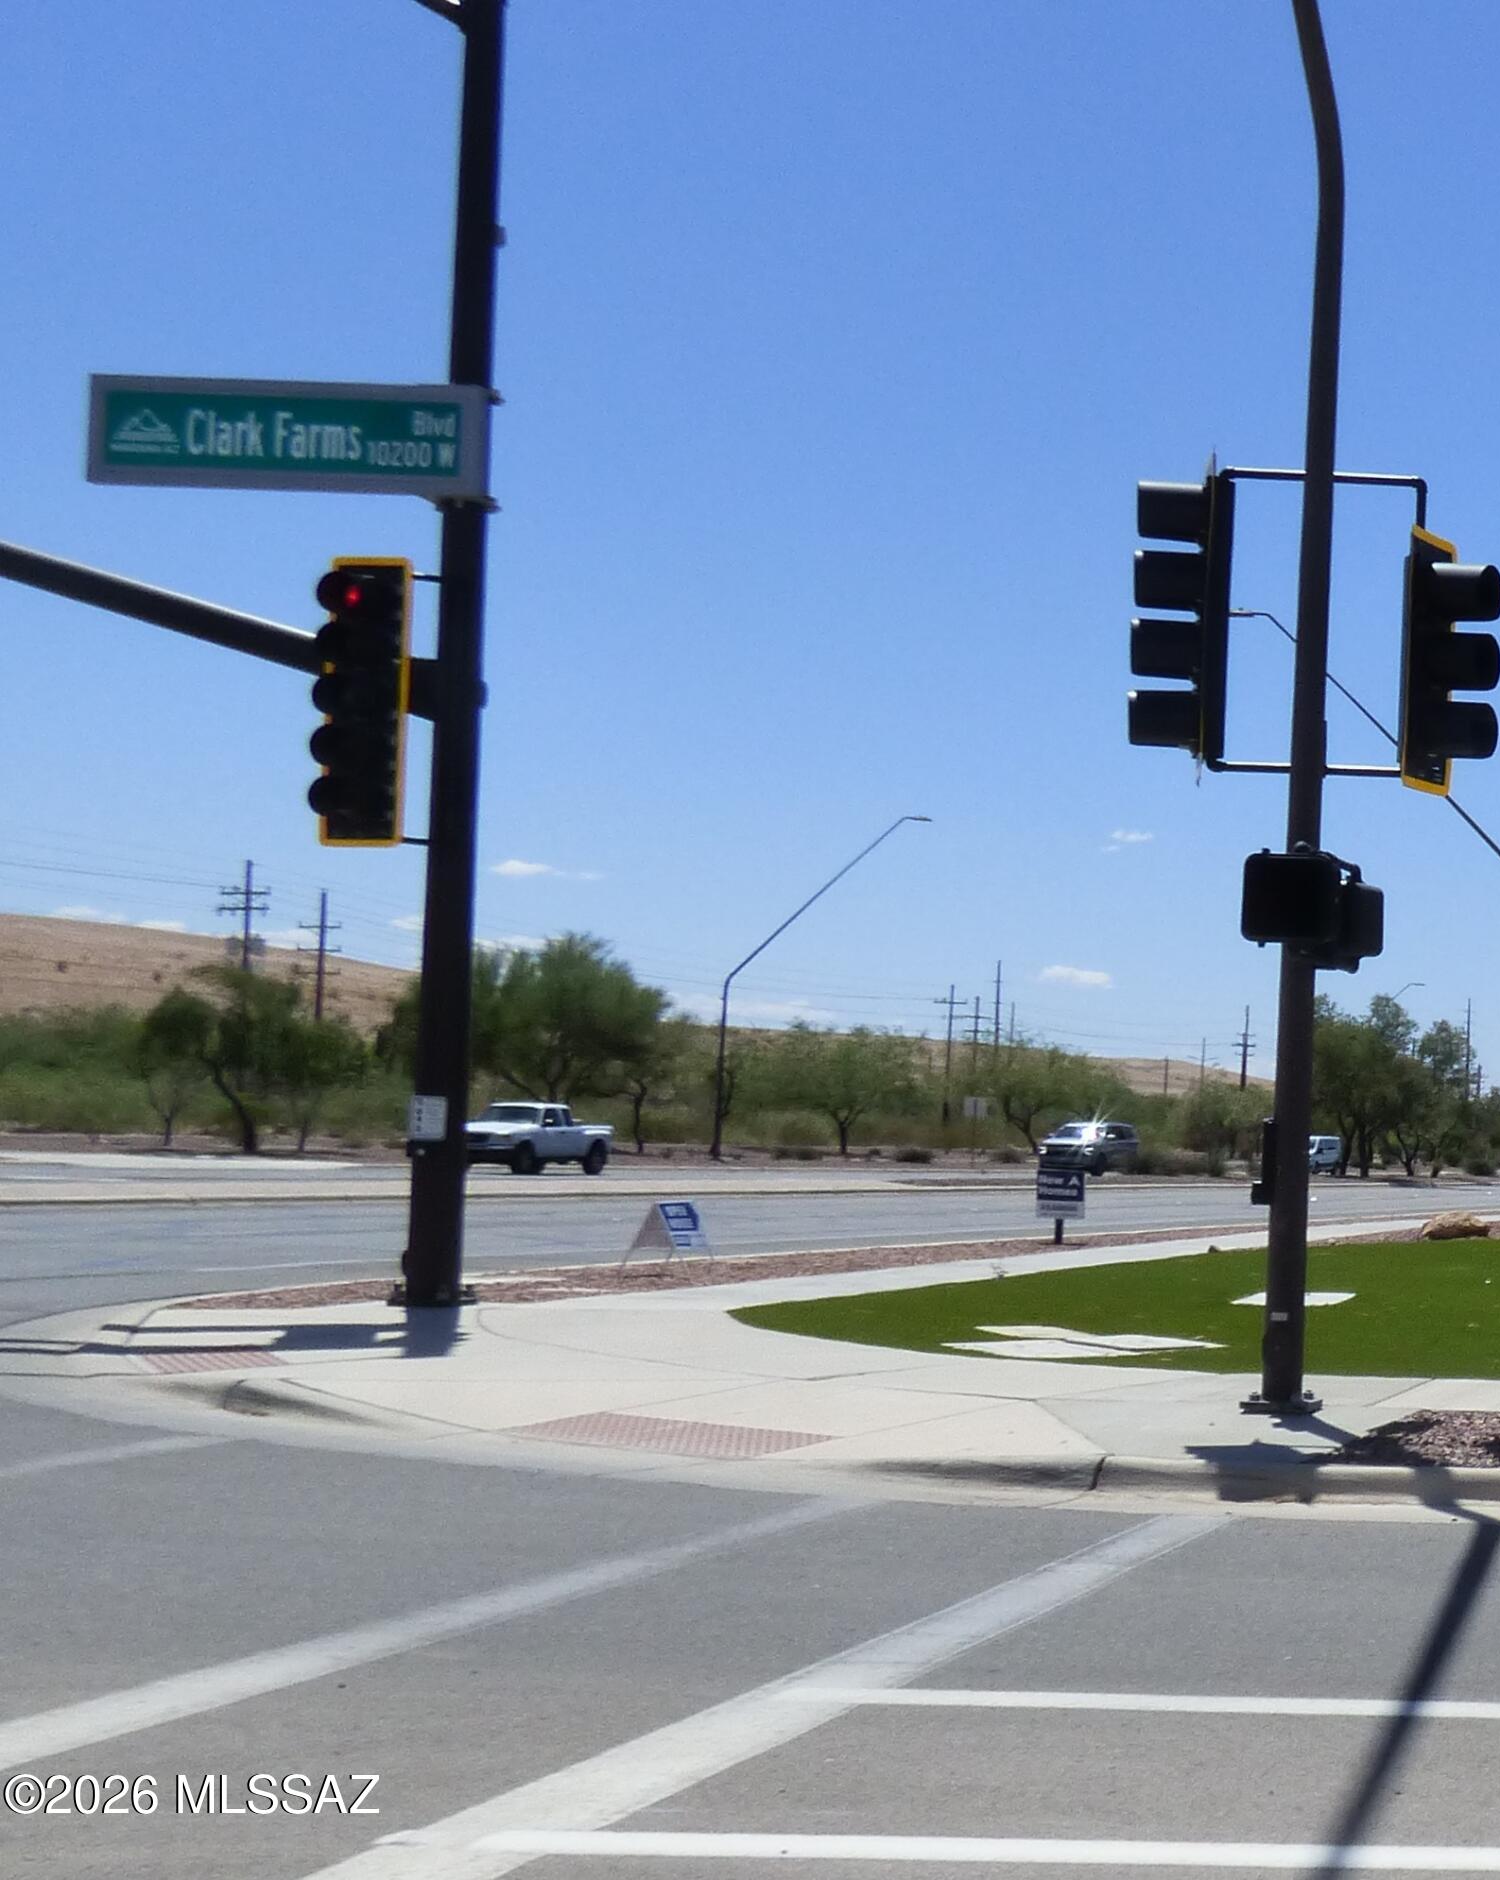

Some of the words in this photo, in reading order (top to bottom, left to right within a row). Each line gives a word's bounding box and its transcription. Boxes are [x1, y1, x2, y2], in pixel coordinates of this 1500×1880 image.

[186, 408, 264, 457] Clark
[273, 411, 362, 460] Farms
[412, 411, 456, 437] Blvd
[367, 441, 432, 468] 10200
[438, 442, 456, 468] W
